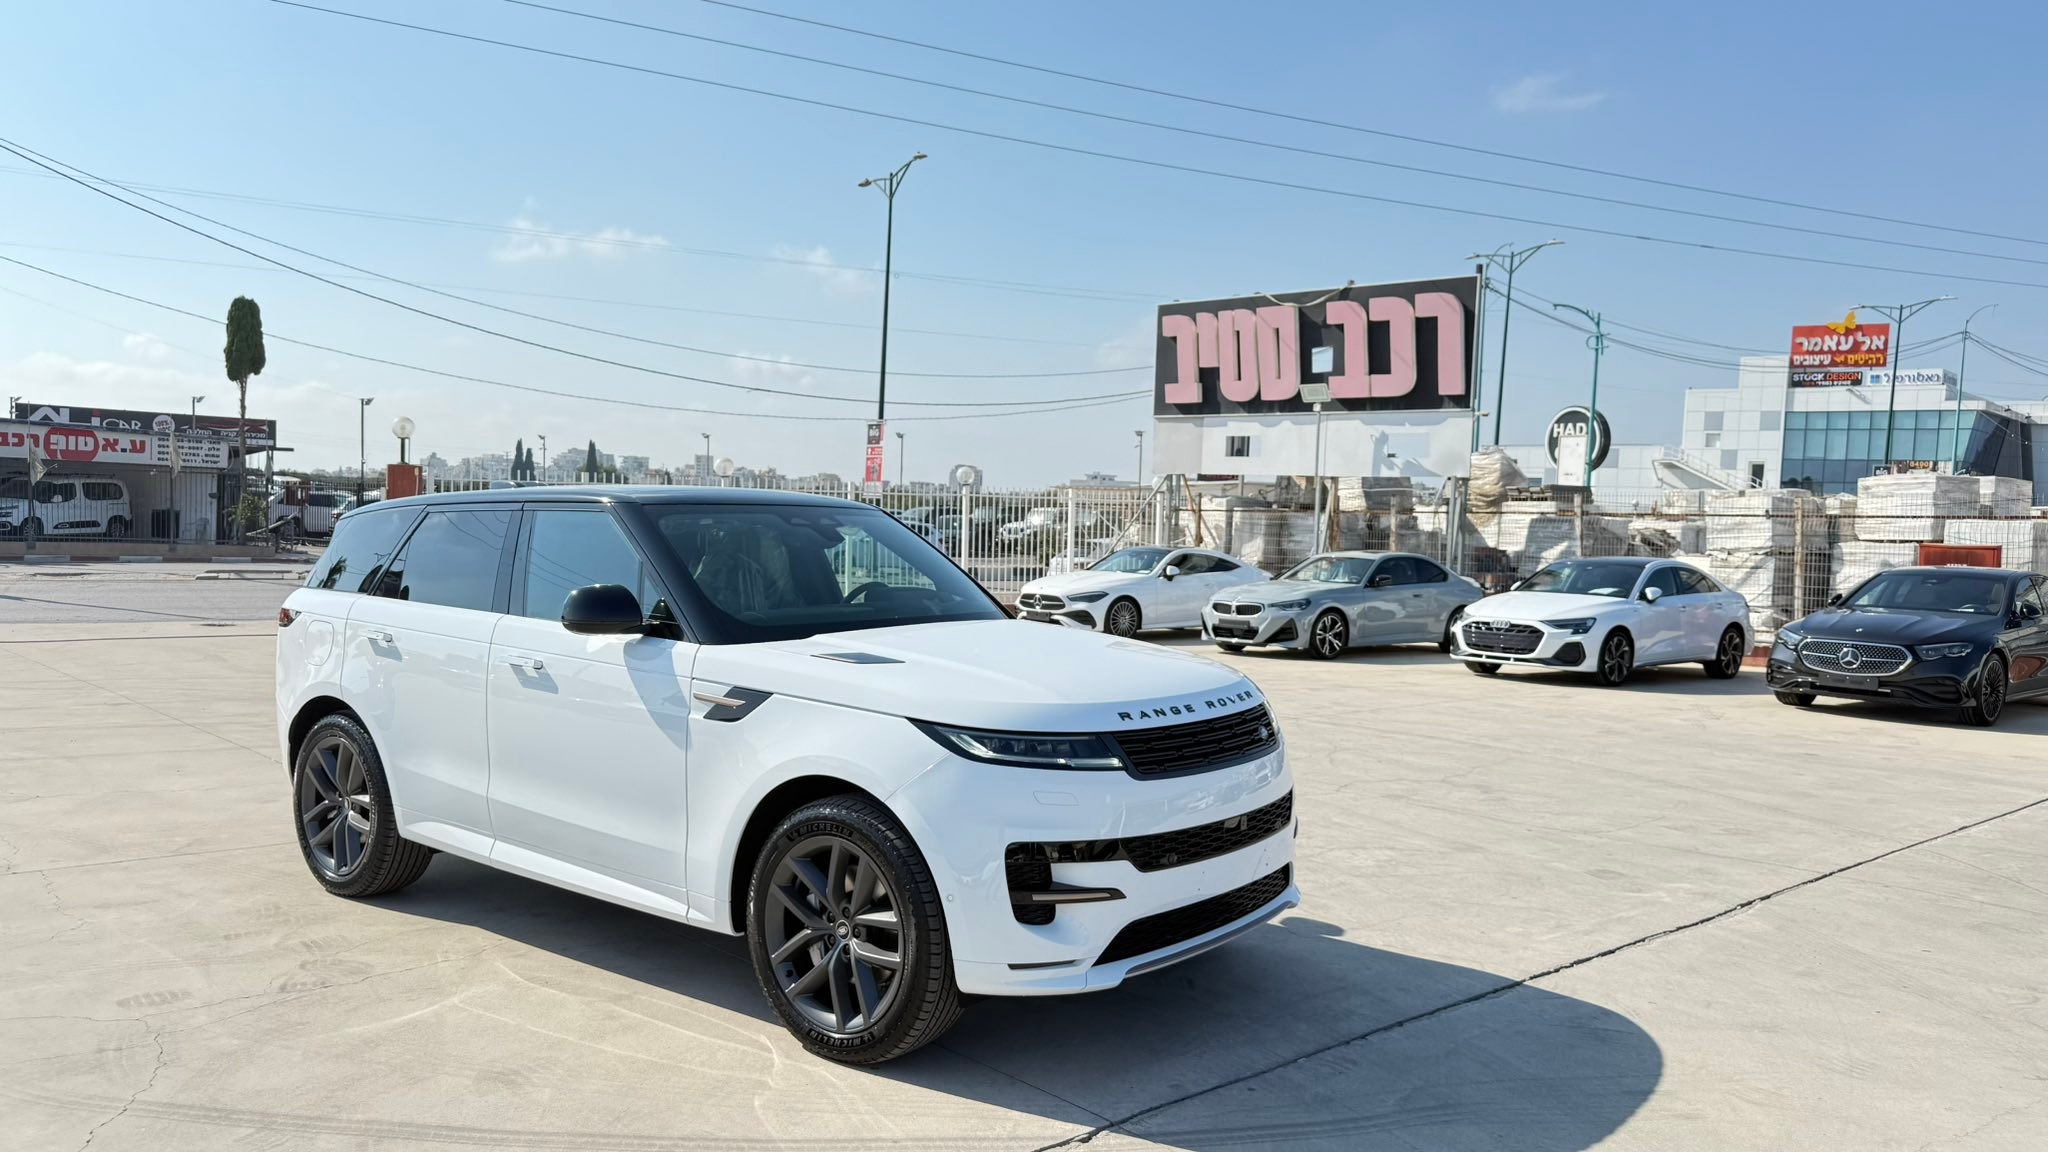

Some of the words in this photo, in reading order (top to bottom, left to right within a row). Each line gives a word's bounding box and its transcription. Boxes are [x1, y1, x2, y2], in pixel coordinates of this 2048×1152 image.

[1326, 292, 1466, 400] רכב
[1795, 335, 1854, 352] עאמר
[1856, 331, 1886, 351] אל
[1792, 373, 1825, 382] STOCK
[1826, 372, 1862, 381] DESIGN
[102, 418, 142, 430] CAR
[1117, 704, 1196, 722] RANGE
[1204, 690, 1254, 710] ROVER
[798, 822, 851, 837] MICHELIN
[809, 1030, 862, 1048] MICHELIN
